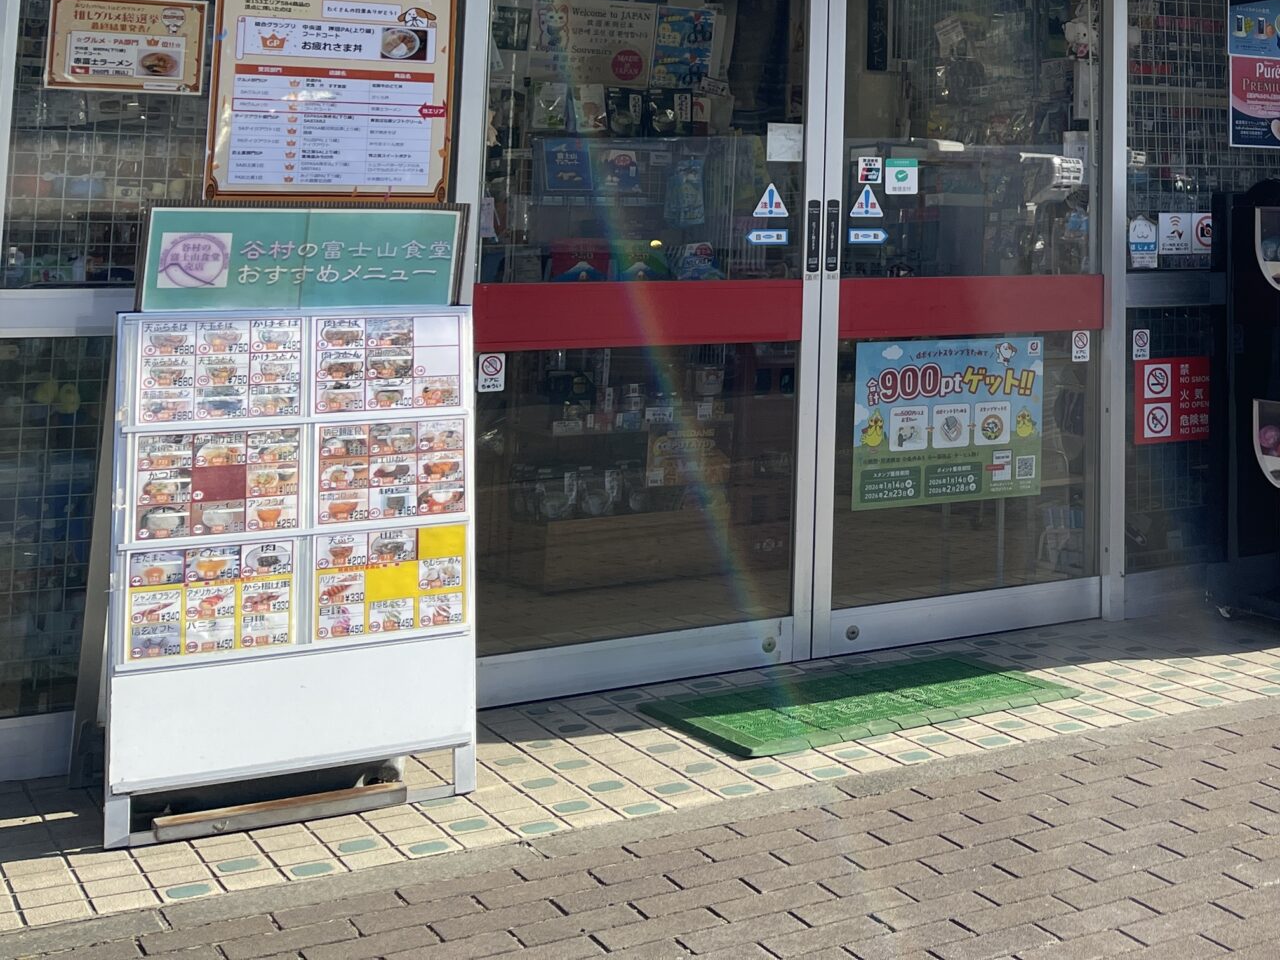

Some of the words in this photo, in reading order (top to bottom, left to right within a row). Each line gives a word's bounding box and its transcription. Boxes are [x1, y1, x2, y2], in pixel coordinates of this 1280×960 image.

[572, 7, 607, 18] Welcome
[621, 11, 651, 20] JAPAN
[301, 41, 363, 53] お疲れさま丼
[239, 240, 451, 261] 谷村の富士山食堂
[238, 265, 437, 285] おすすめメニュー
[1180, 401, 1190, 409] NO
